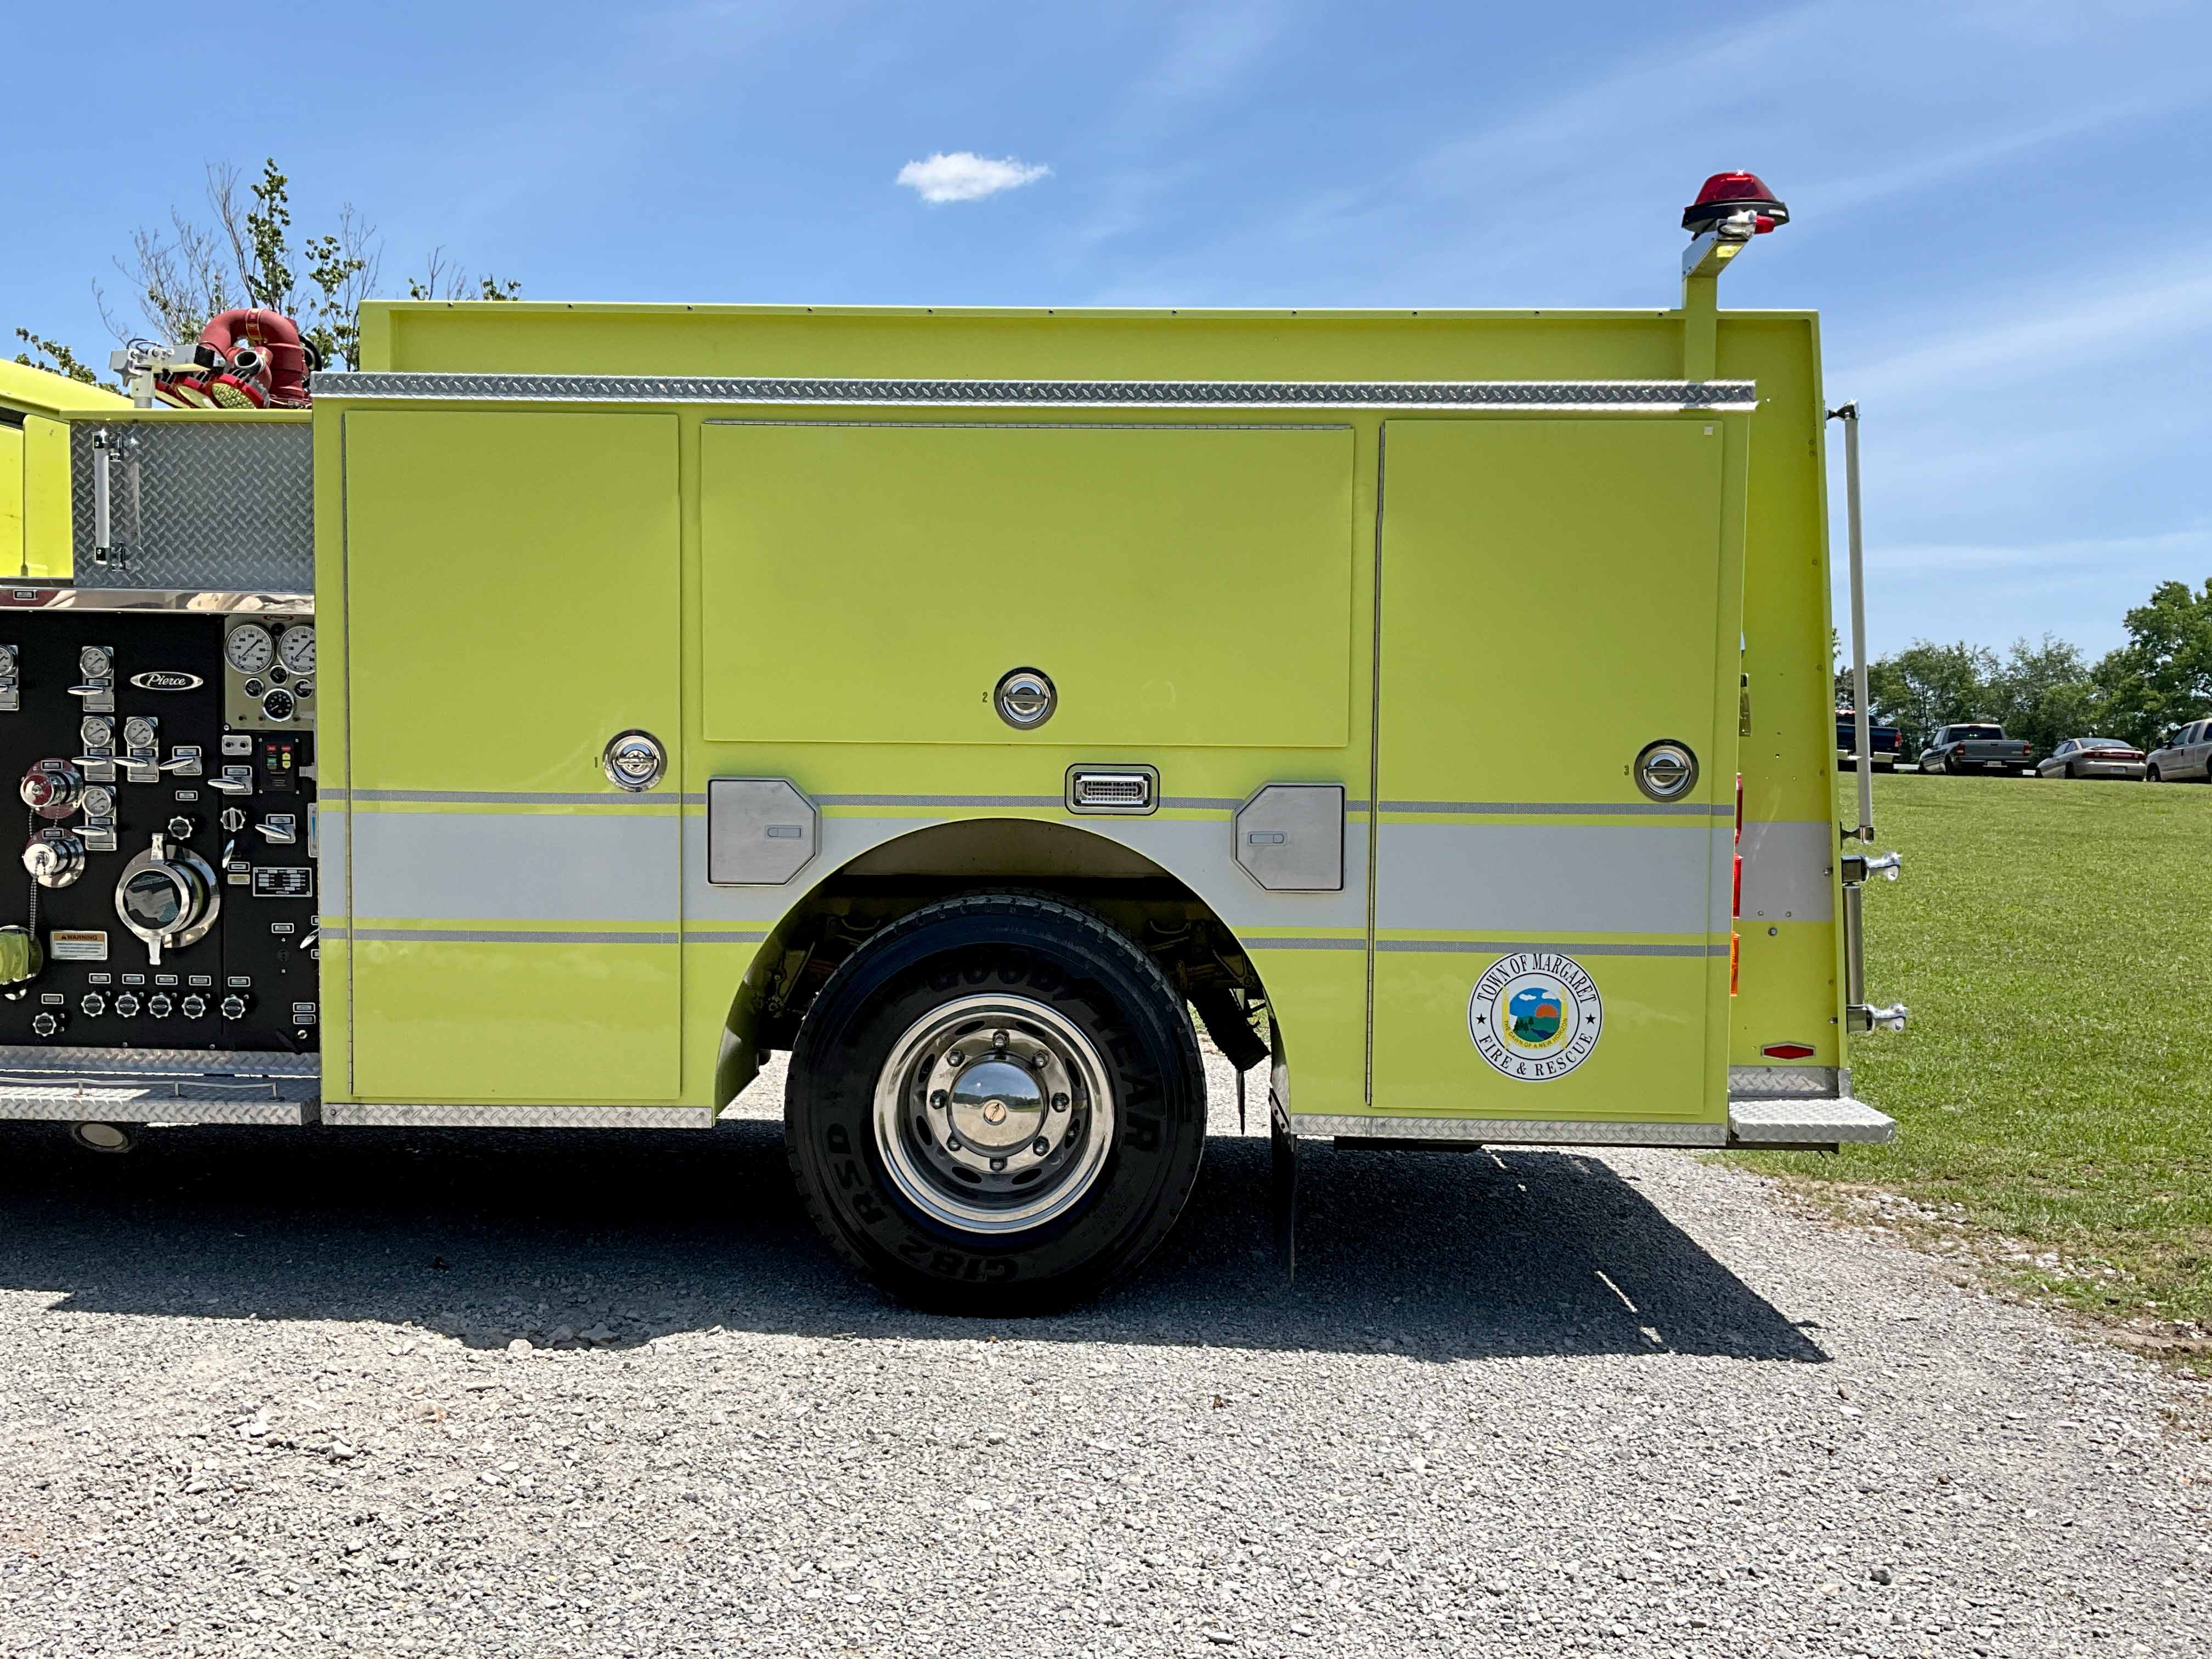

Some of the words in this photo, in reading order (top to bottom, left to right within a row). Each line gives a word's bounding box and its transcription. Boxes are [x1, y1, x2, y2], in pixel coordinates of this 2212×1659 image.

[146, 674, 186, 687] Pierce
[982, 691, 988, 703] 2
[1624, 764, 1629, 776] 3
[1477, 964, 1510, 1002] TOWN
[1510, 955, 1527, 974] OF
[1532, 953, 1596, 1003] MARGARET
[1509, 1031, 1524, 1047] DAWN
[1539, 1039, 1552, 1047] NEW
[1552, 1018, 1567, 1041] HORIZON
[1479, 1034, 1513, 1069] FIRE
[1517, 1062, 1527, 1075] &
[1536, 1032, 1593, 1076] RESCUE
